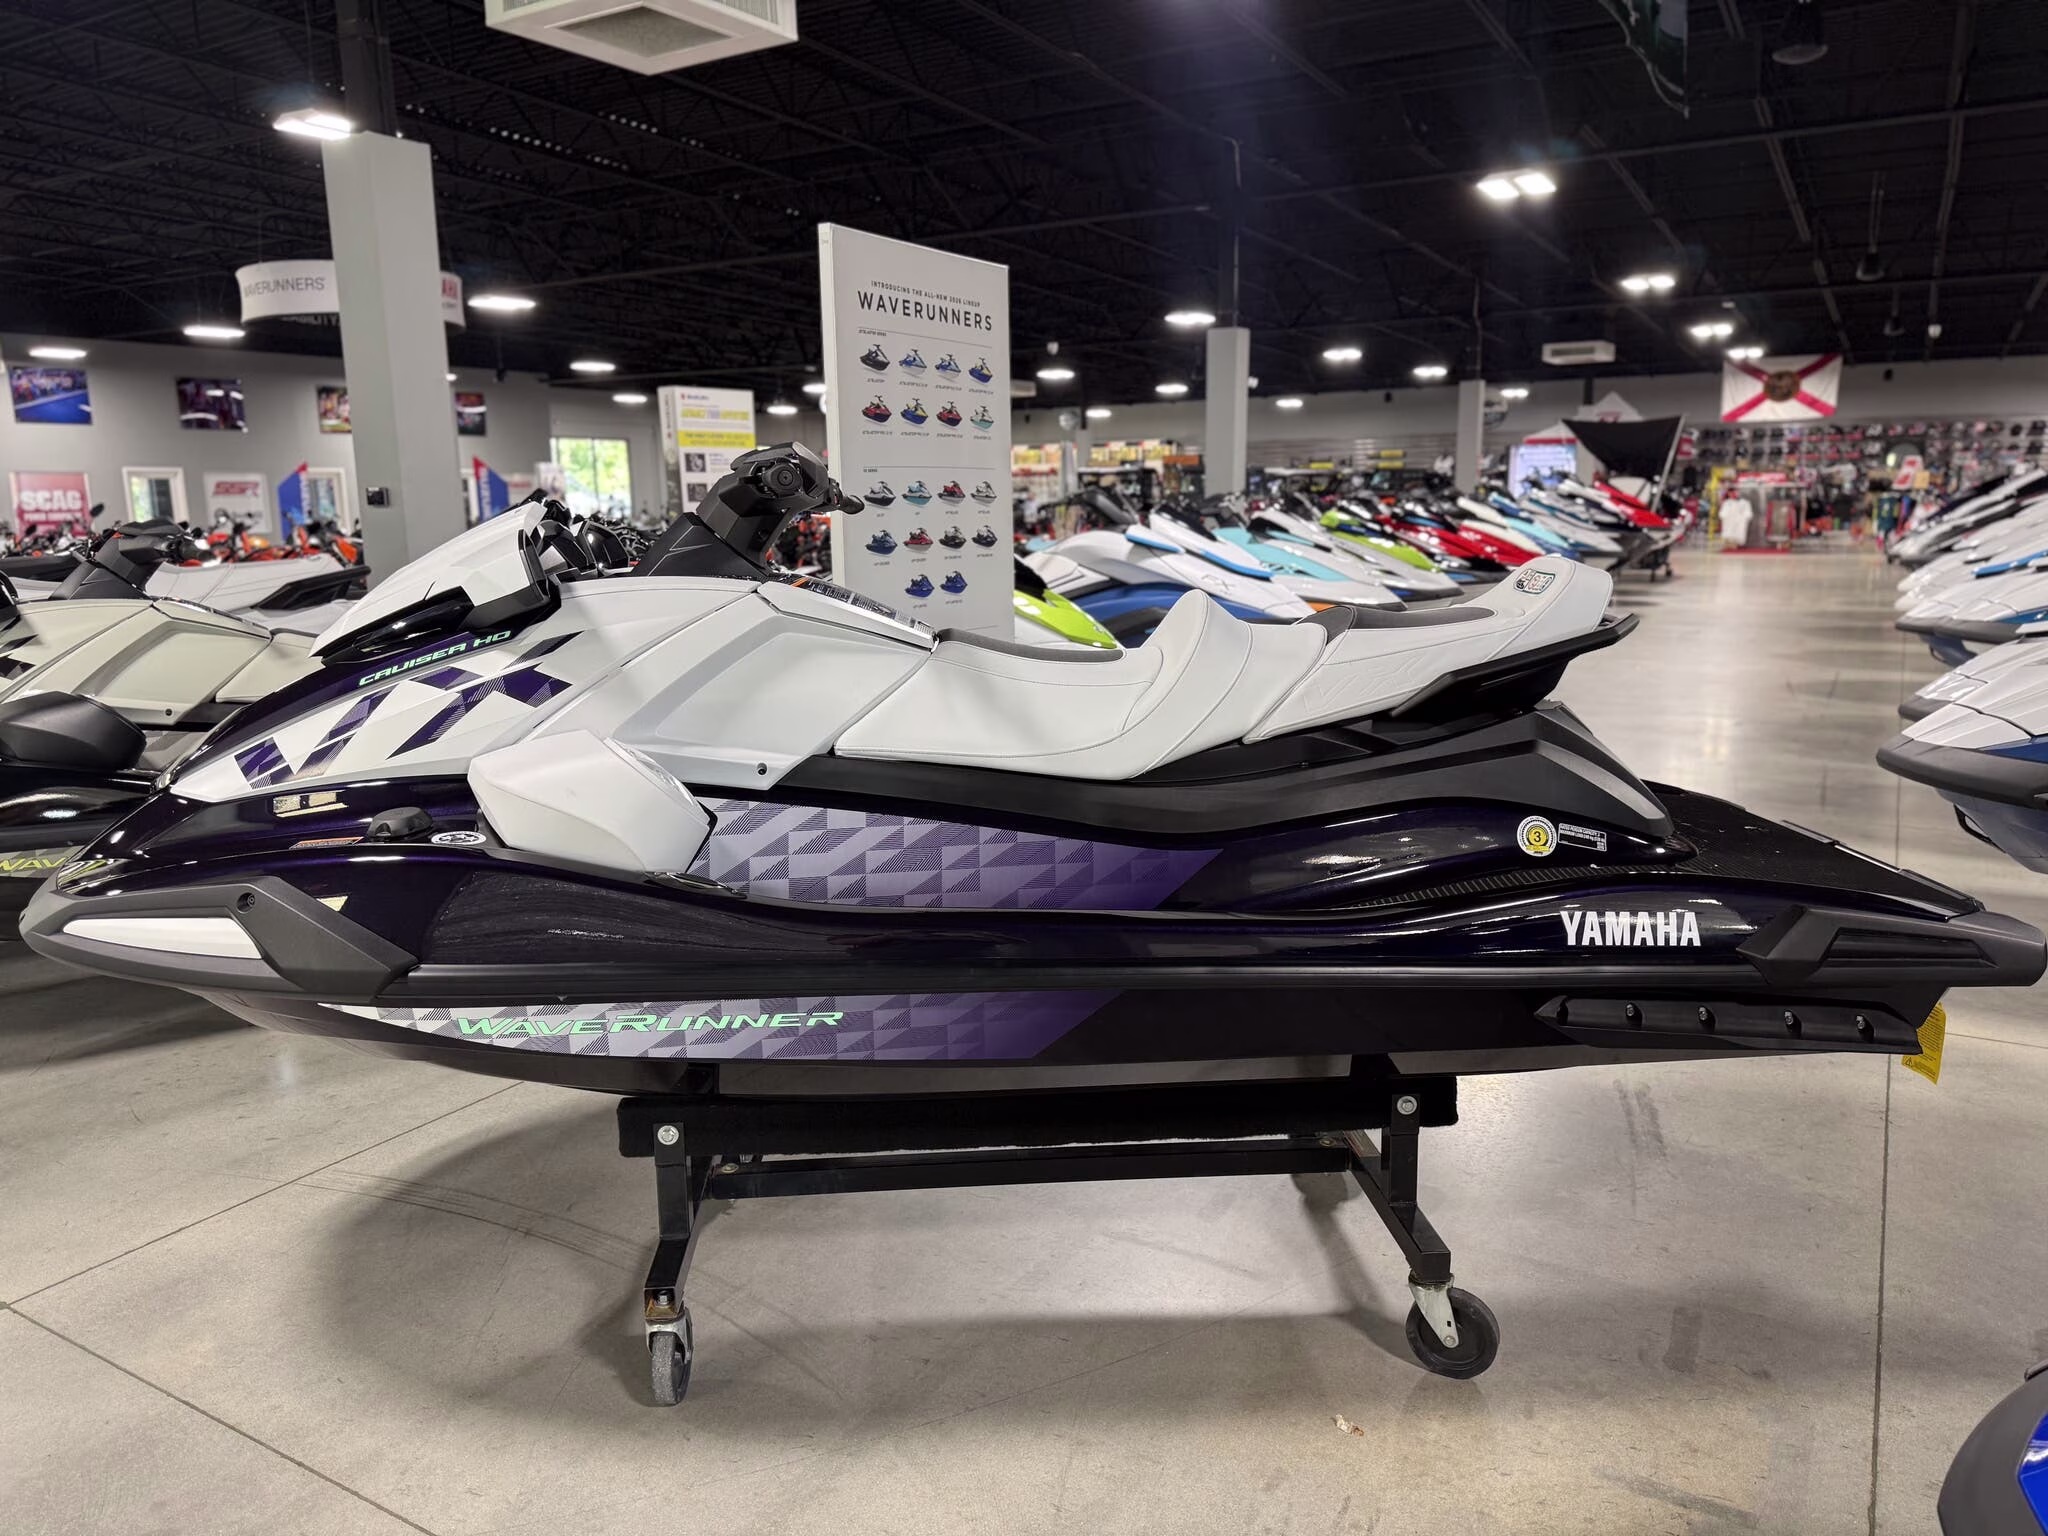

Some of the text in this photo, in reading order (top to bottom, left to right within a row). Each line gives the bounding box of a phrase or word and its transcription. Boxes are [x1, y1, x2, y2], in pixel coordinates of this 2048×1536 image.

[871, 280, 910, 294] INTRODUCING
[912, 288, 922, 297] THE
[858, 291, 992, 331] WAVERUNNERS
[20, 489, 82, 511] SCAG
[359, 630, 512, 686] CRUISER HO
[1560, 911, 1701, 946] YAMAHA
[456, 1011, 844, 1036] WAVERUNNER
